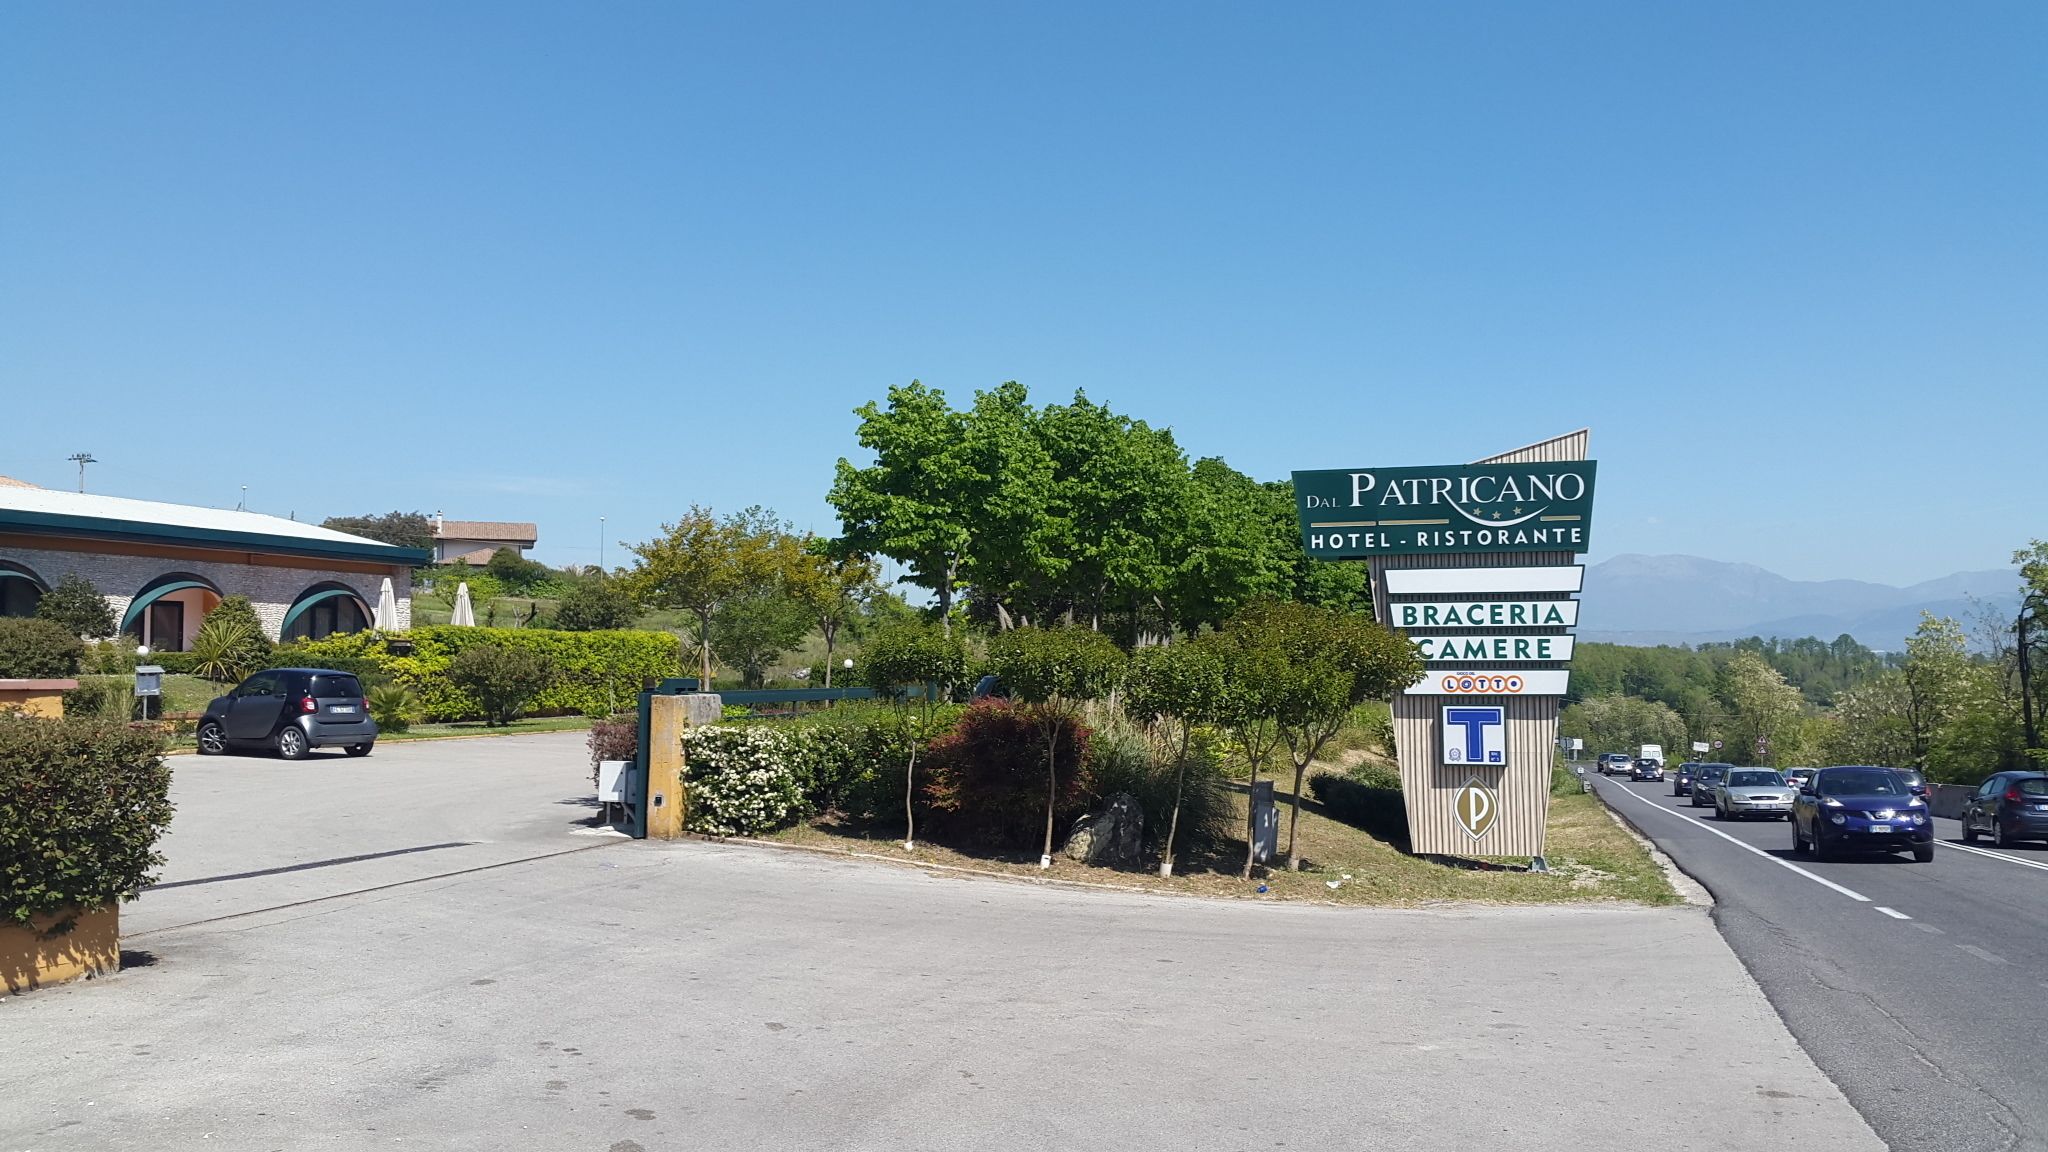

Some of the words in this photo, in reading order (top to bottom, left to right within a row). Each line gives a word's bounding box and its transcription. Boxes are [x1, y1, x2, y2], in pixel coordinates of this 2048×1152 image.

[1306, 495, 1341, 509] DAL
[1348, 472, 1585, 510] PATRICANO
[1311, 533, 1391, 549] HOTEL
[1417, 527, 1582, 547] RISTORANTE
[1402, 603, 1565, 626] BRACERIA
[1418, 638, 1552, 660] CAMERE
[1442, 675, 1524, 693] LOTTO
[1446, 708, 1502, 763] T
